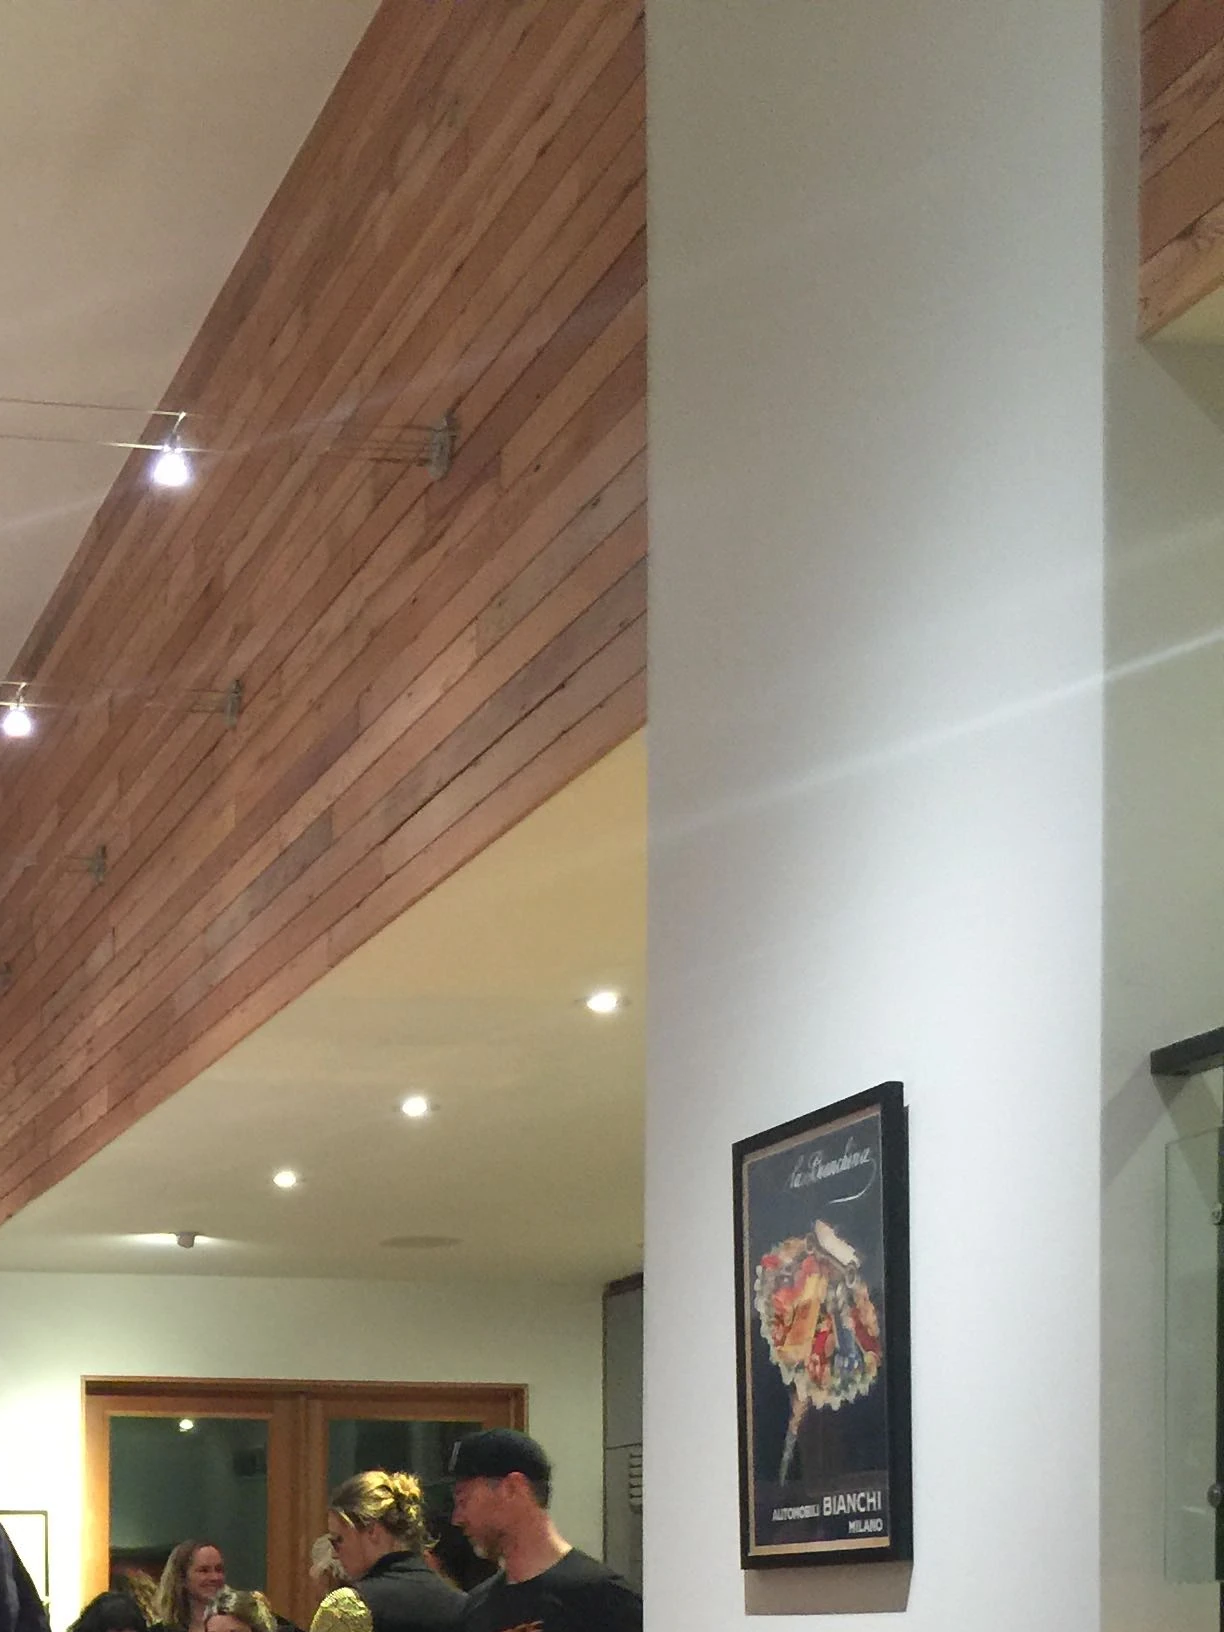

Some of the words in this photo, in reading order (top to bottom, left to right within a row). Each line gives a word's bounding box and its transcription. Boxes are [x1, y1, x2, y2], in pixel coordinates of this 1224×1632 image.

[772, 1504, 820, 1521] AUTOMOBILI
[822, 1490, 882, 1517] BIANCHI
[848, 1518, 884, 1534] MILANO
